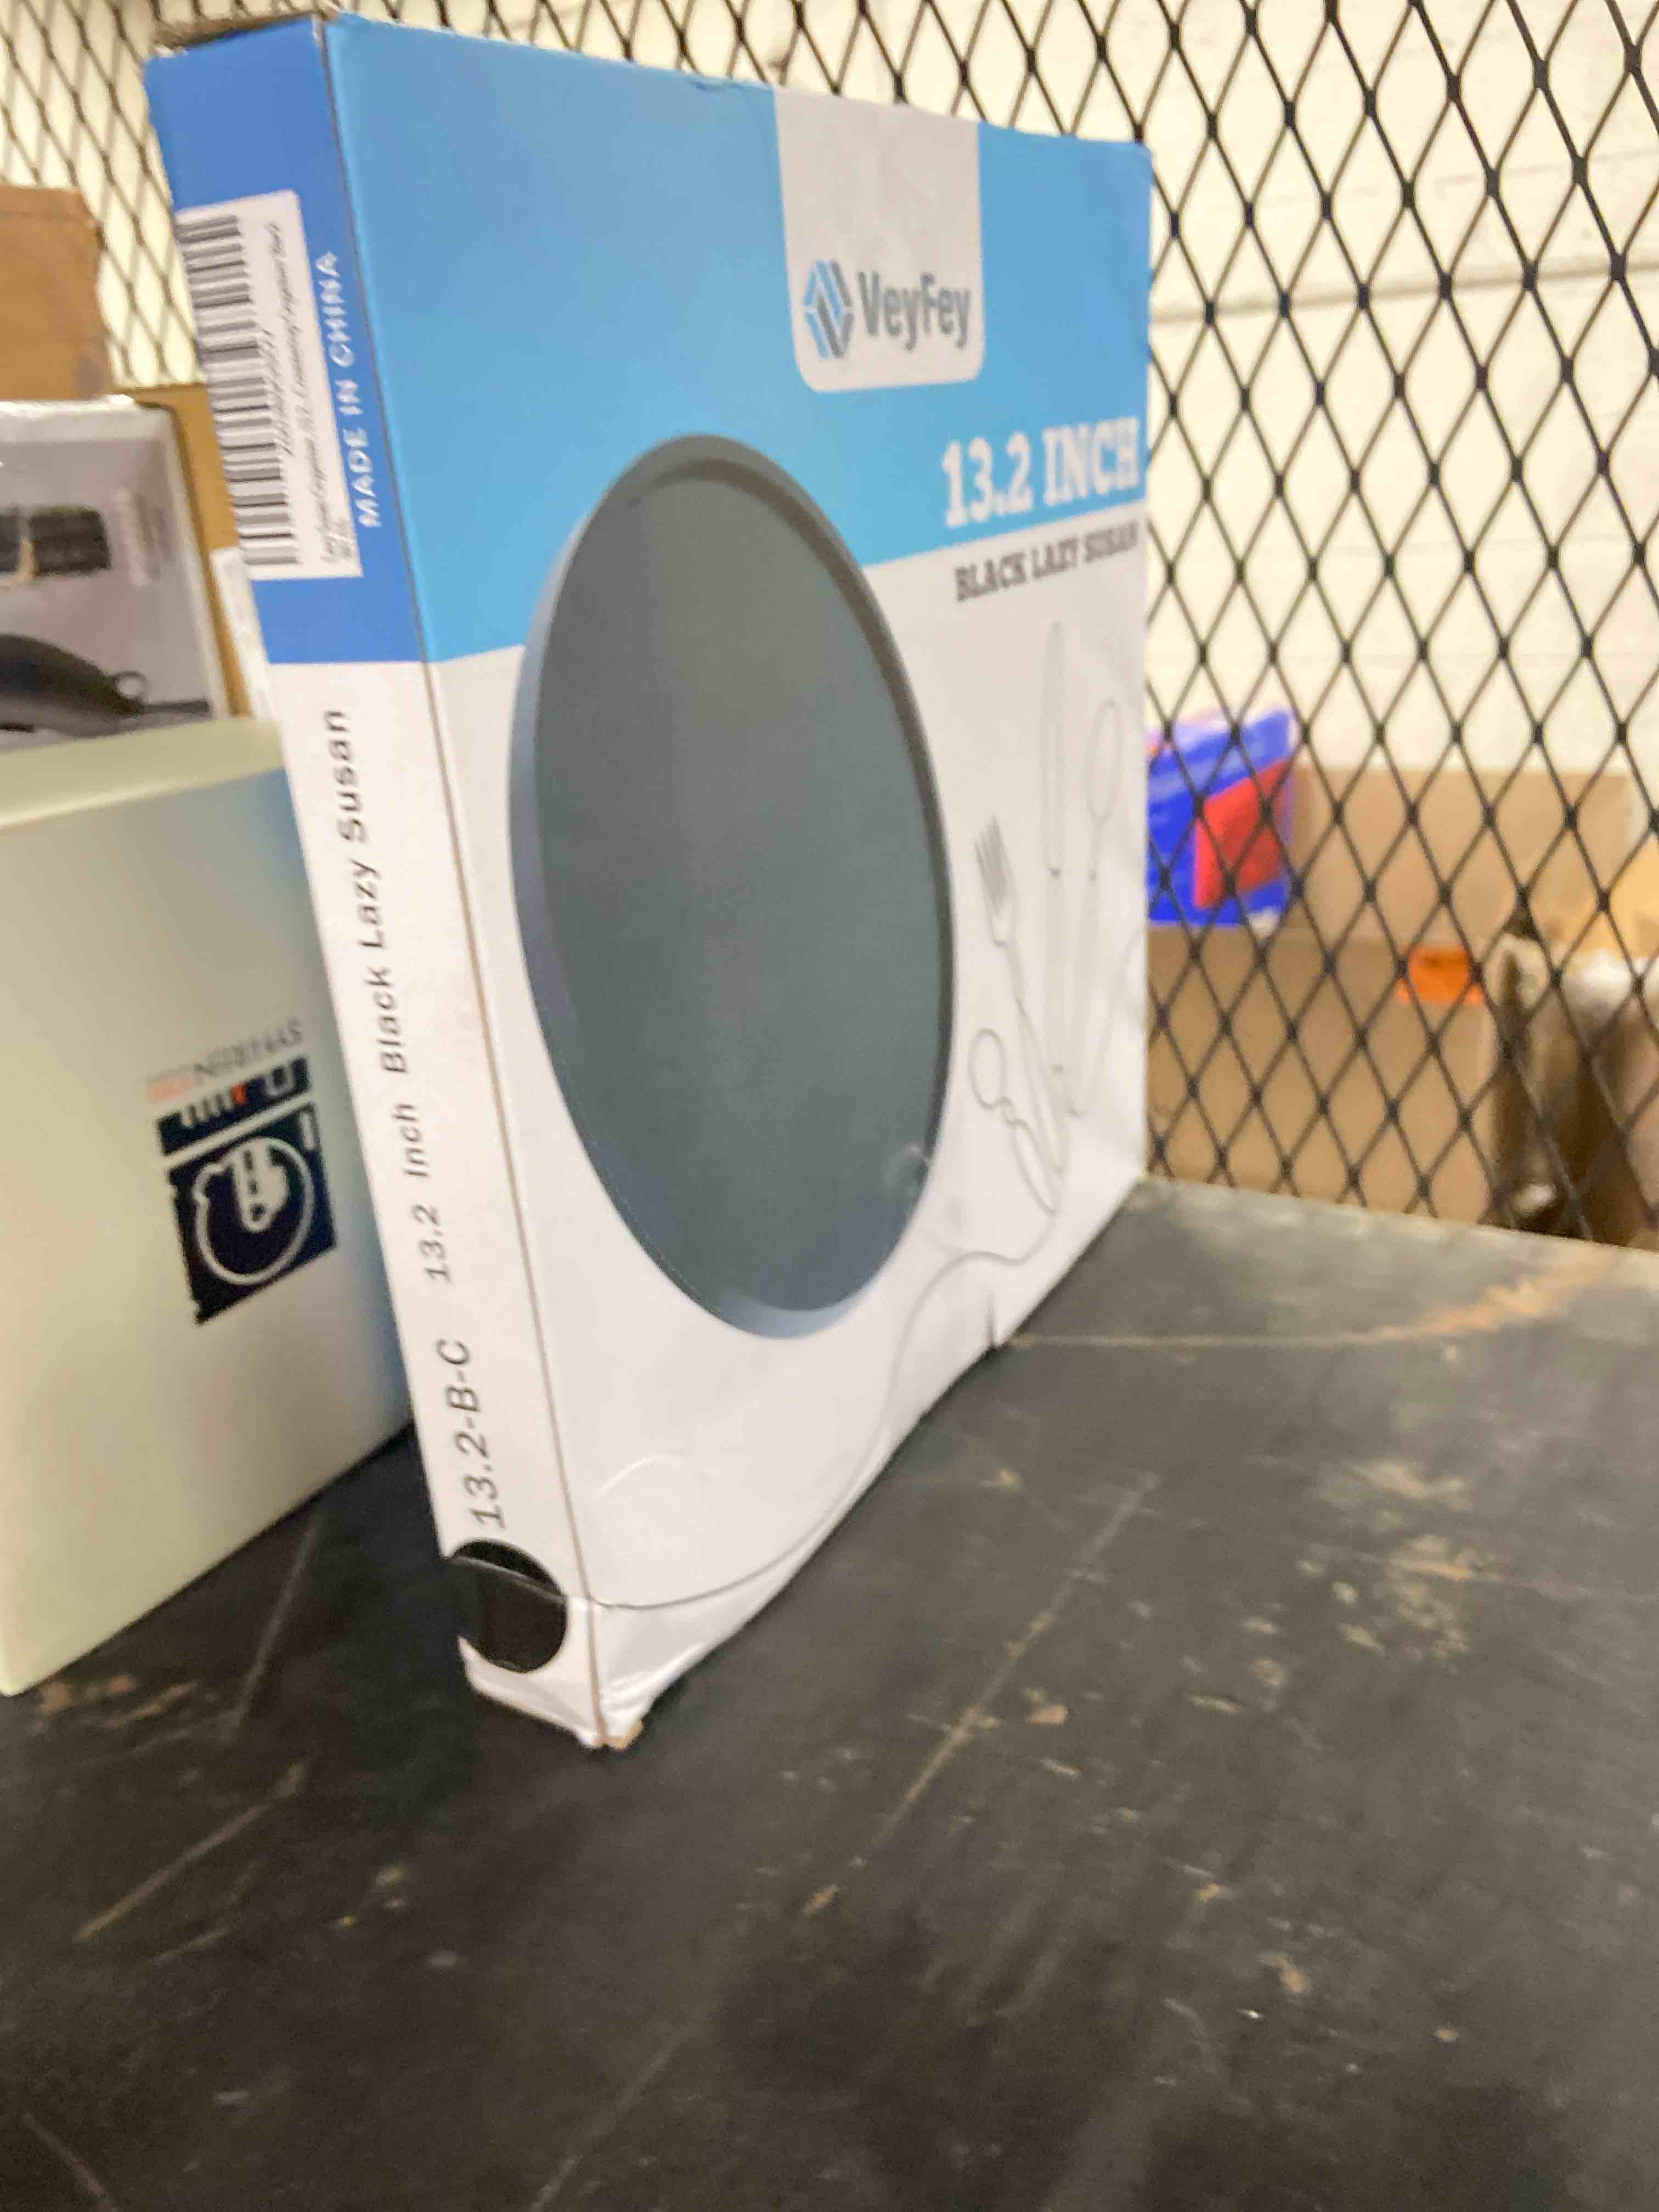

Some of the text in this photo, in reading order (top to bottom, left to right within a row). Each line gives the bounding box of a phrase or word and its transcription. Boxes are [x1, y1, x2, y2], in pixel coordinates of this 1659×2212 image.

[857, 271, 970, 352] VeyFey
[315, 251, 382, 528] MADE IN CHINA
[941, 415, 1139, 528] 13.2 INCH
[955, 520, 1138, 602] BLACK LAZY SUSAN
[324, 710, 505, 1530] 13.2-B-C 13.2 Inch Black Lazy Susan
